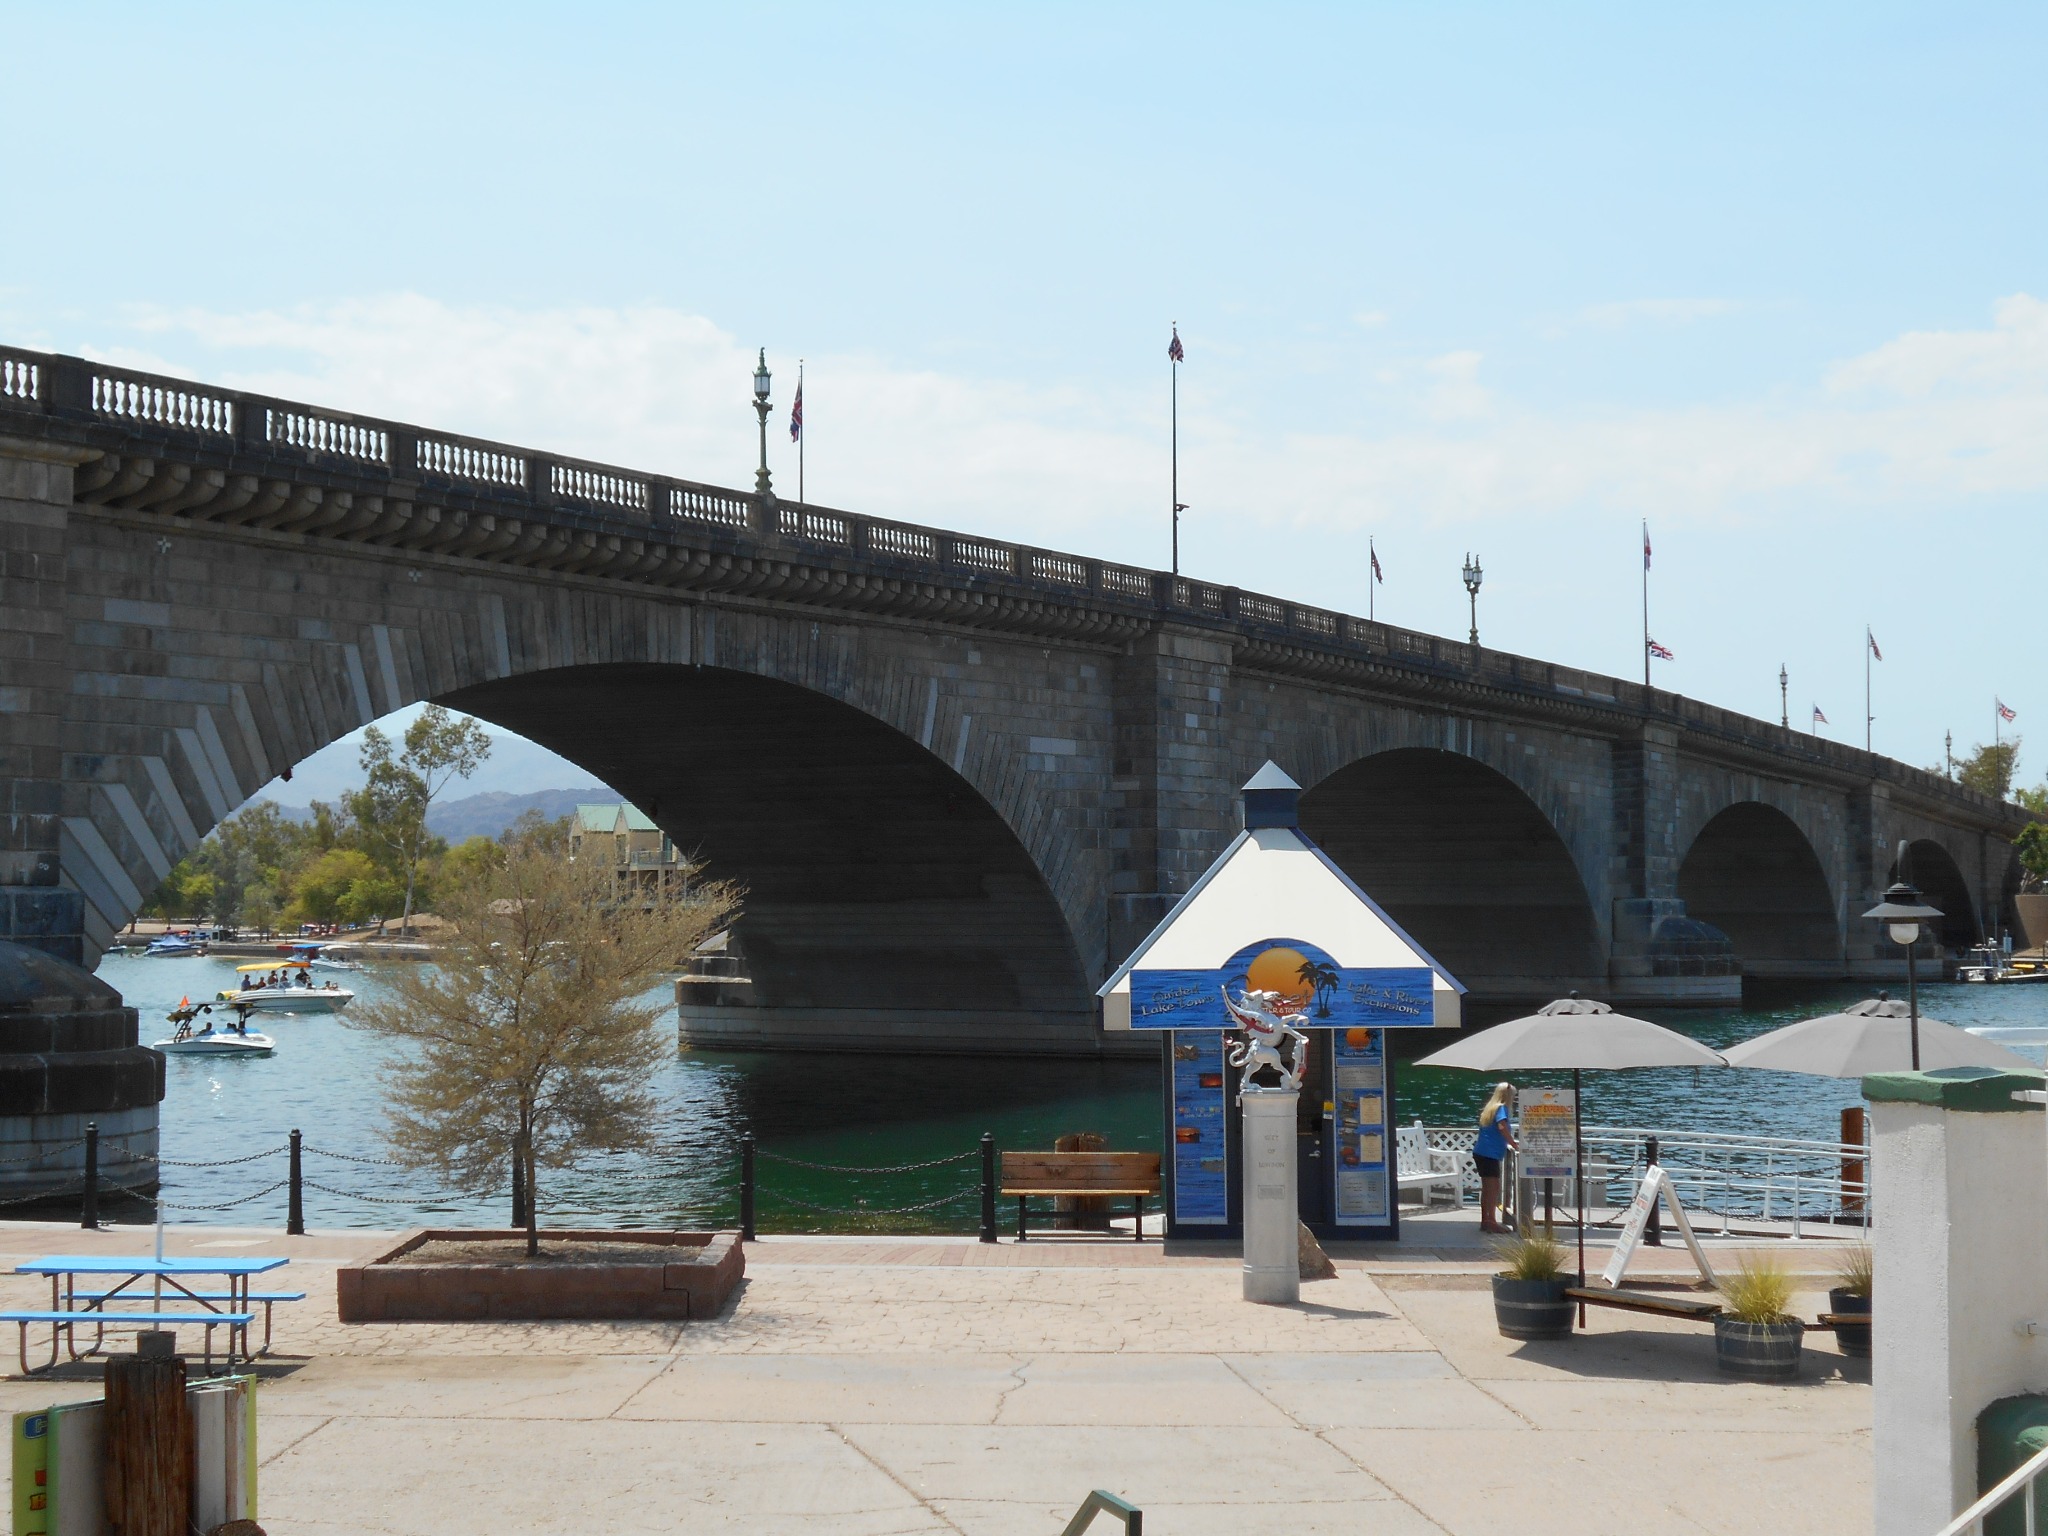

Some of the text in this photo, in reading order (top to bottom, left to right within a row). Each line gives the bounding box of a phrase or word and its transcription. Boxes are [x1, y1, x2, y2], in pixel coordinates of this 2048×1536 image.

[1152, 984, 1199, 1002] Guided
[1347, 981, 1429, 1006] Lake & River
[1141, 1002, 1175, 1016] Lake
[1353, 993, 1420, 1016] Excursions
[1523, 1105, 1574, 1113] SUNSET EXPERIENCE
